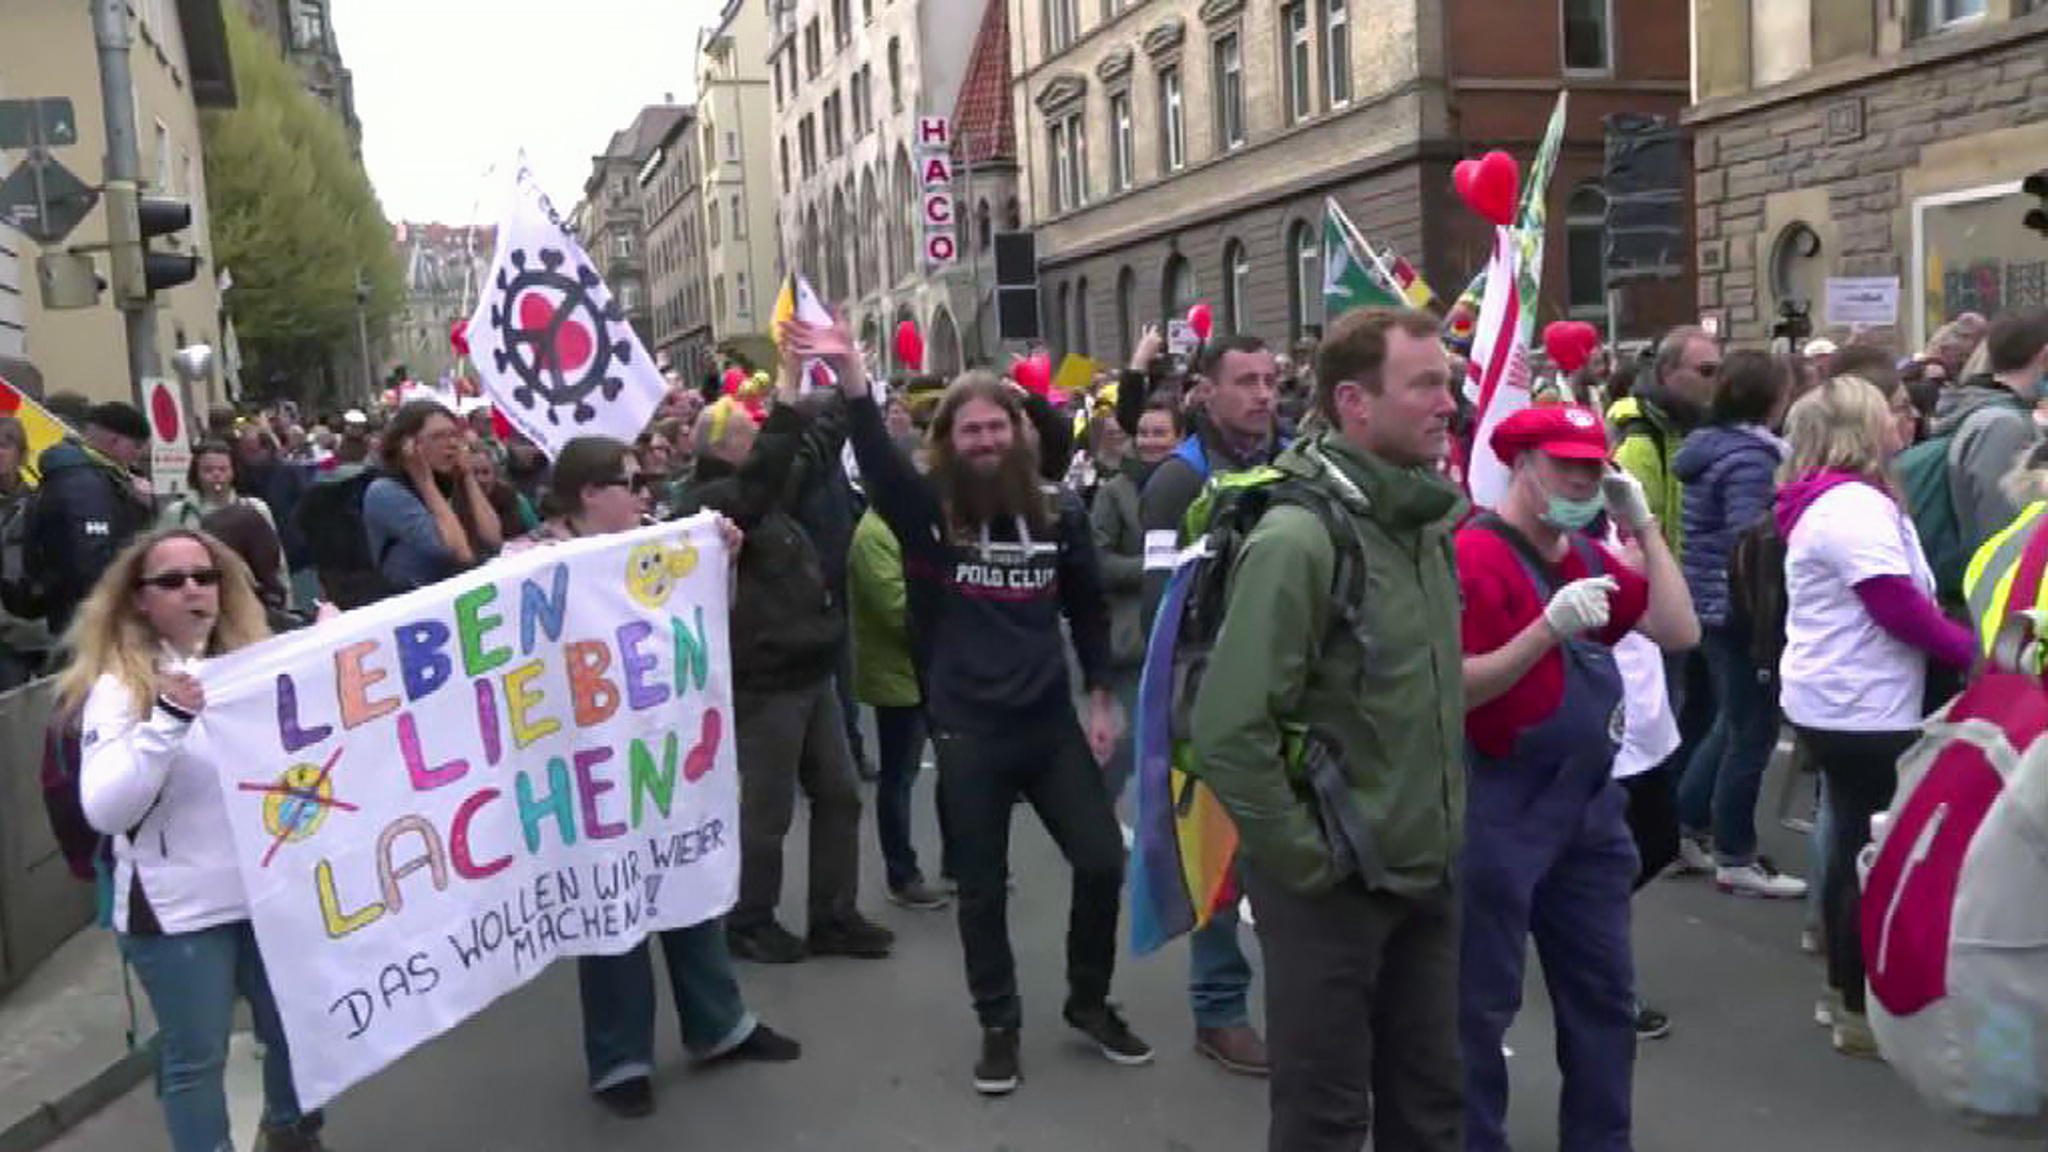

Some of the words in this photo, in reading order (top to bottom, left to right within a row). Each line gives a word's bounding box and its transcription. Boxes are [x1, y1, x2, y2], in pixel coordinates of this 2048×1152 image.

[921, 119, 953, 260] HACO
[955, 563, 1004, 587] POLO
[277, 562, 569, 753] LEBEN
[398, 605, 708, 791] LIEBEN
[328, 951, 439, 1040] DAS
[448, 866, 580, 969] WOLLEN
[593, 850, 641, 902] WIR
[649, 818, 725, 868] WIEDER
[513, 874, 663, 975] MACHEN!
